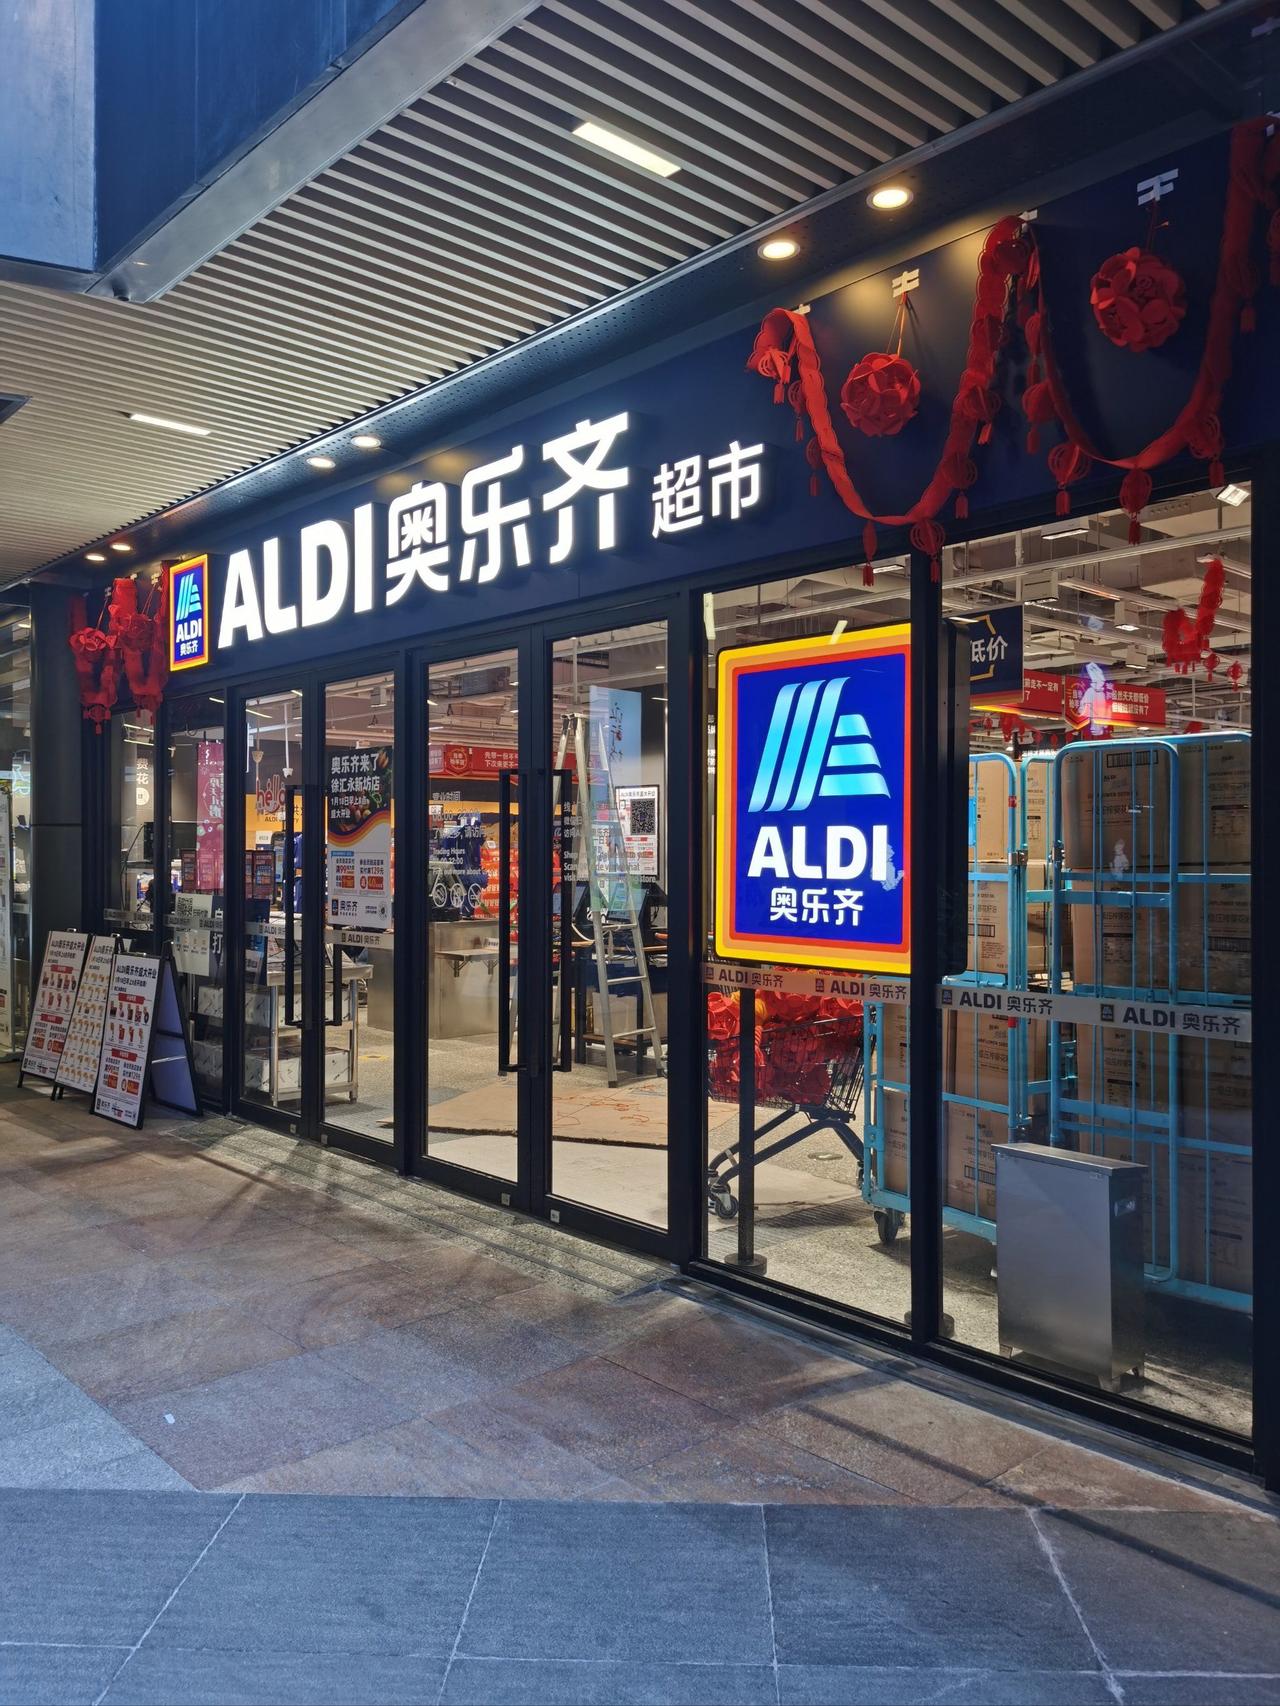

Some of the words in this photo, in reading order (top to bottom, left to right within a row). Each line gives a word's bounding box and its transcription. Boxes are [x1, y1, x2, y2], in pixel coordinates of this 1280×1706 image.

[652, 441, 765, 538] 超市
[176, 618, 202, 643] ALDI
[180, 640, 198, 656] 奥乐齐
[331, 753, 379, 774] 奥乐齐来了
[331, 776, 380, 793] 徐汇永新坊店
[432, 791, 461, 801] 营业时间
[331, 808, 350, 818] 盛大开业
[747, 825, 888, 880] ALDI
[770, 886, 863, 926] 奥乐齐
[265, 925, 276, 935] ALDI
[348, 932, 363, 943] ALDI
[718, 969, 748, 984] ALDI
[751, 973, 784, 988] 奥乐齐
[831, 980, 865, 996] ALDI
[870, 983, 907, 1000] 奥乐齐
[959, 991, 1001, 1010] ALDI
[1007, 996, 1053, 1015] 奥乐齐
[1123, 1007, 1175, 1028] ALDI
[1182, 1013, 1240, 1036] 奥乐齐
